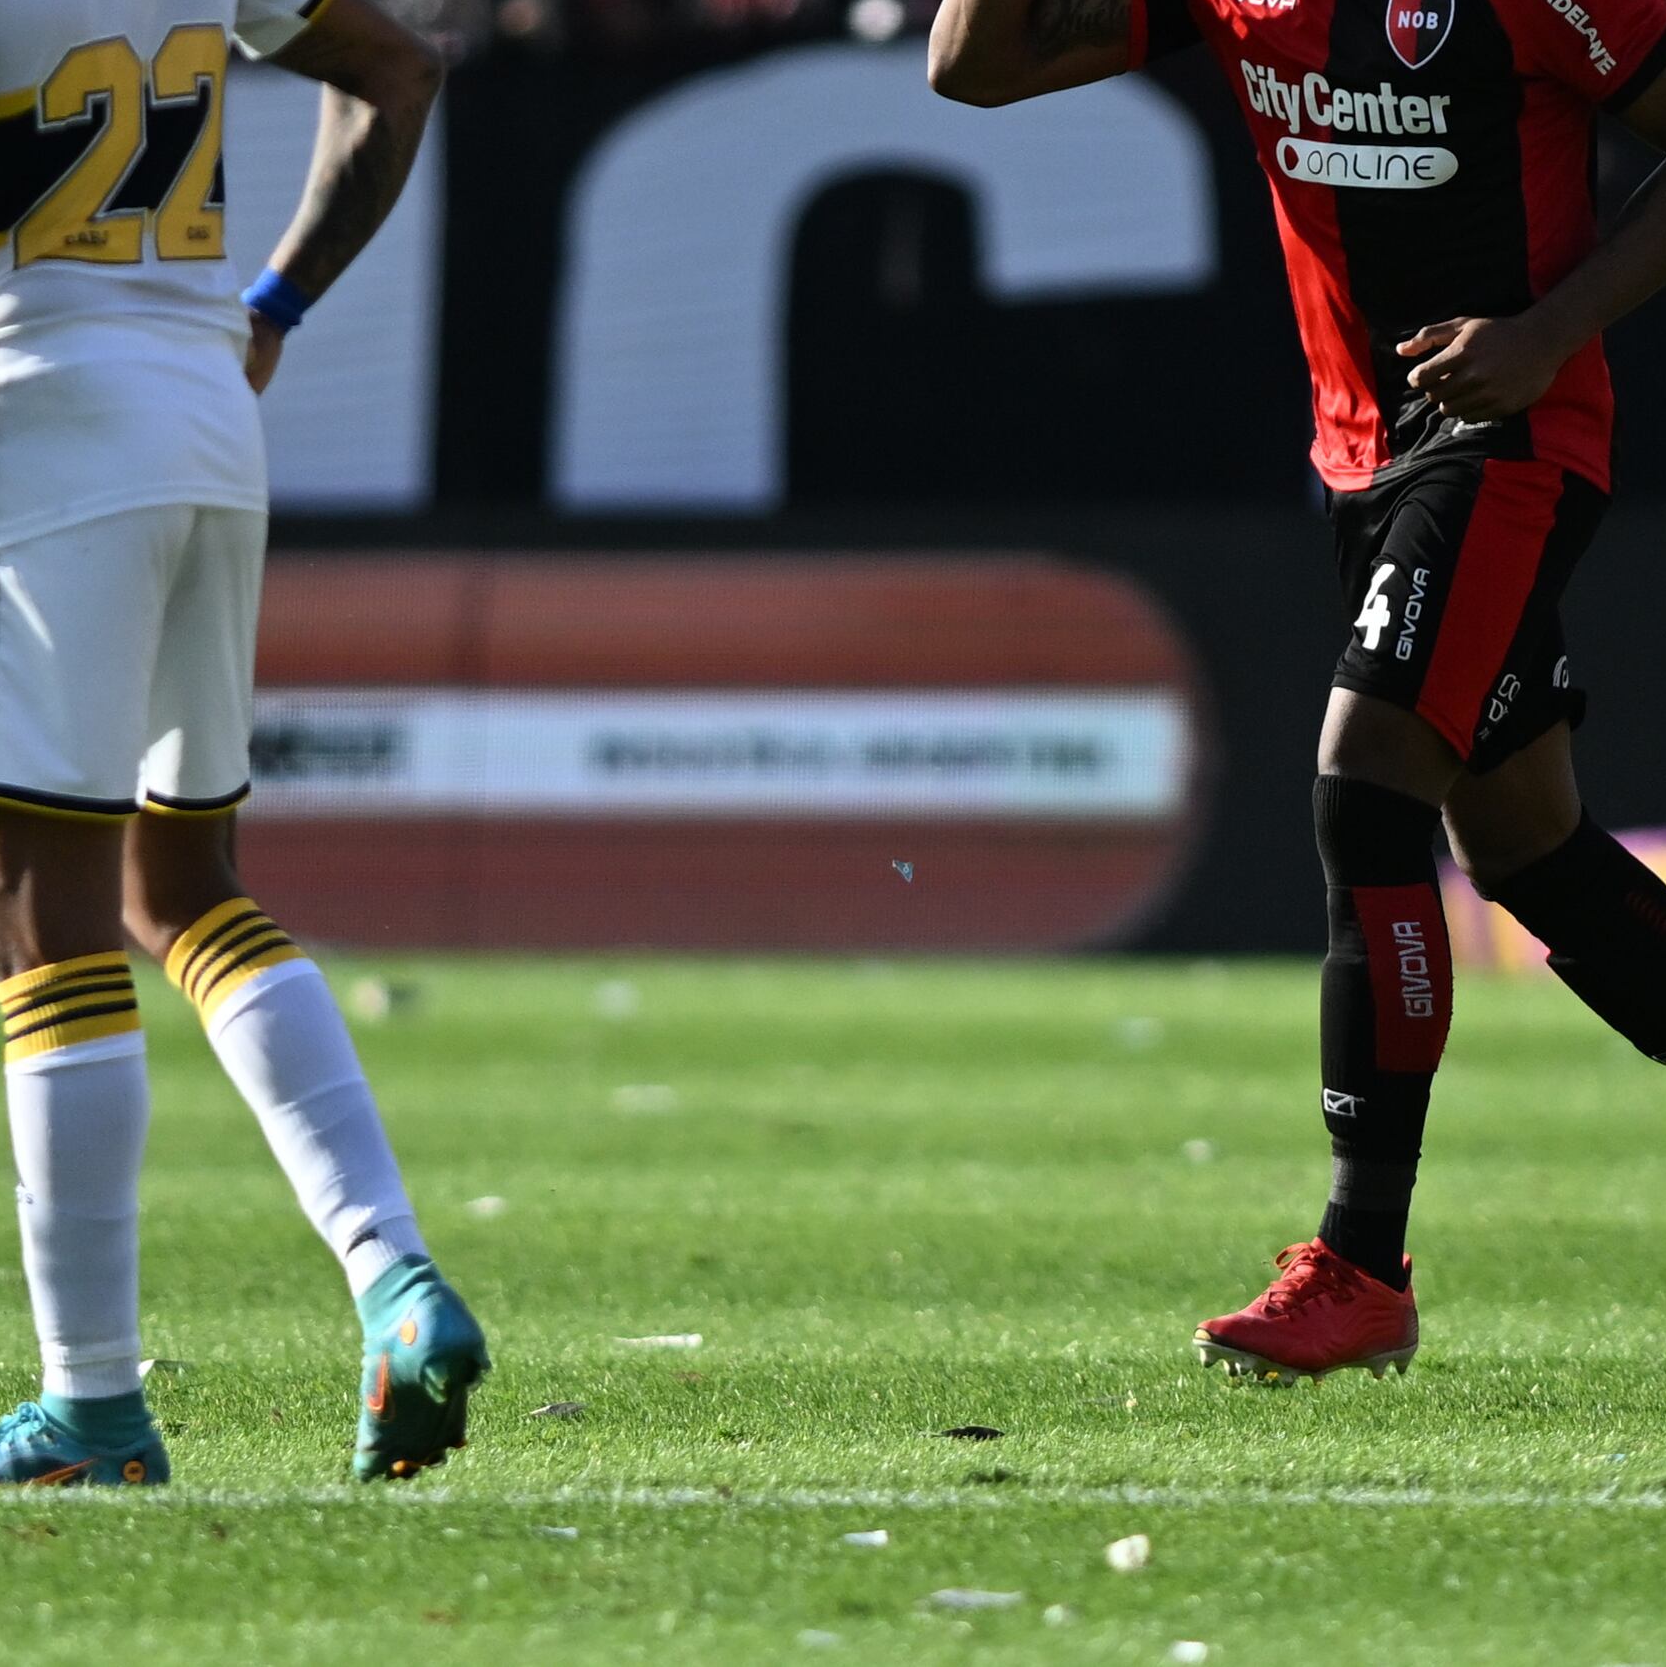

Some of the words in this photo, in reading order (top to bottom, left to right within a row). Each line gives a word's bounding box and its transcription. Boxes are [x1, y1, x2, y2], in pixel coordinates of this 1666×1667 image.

[1397, 10, 1439, 29] NOB
[13, 21, 227, 270] 22
[1307, 150, 1436, 181] ONLINE
[1354, 563, 1396, 651] 4
[1395, 567, 1430, 661] GIVOVA
[1392, 921, 1434, 1017] GIVOVA
